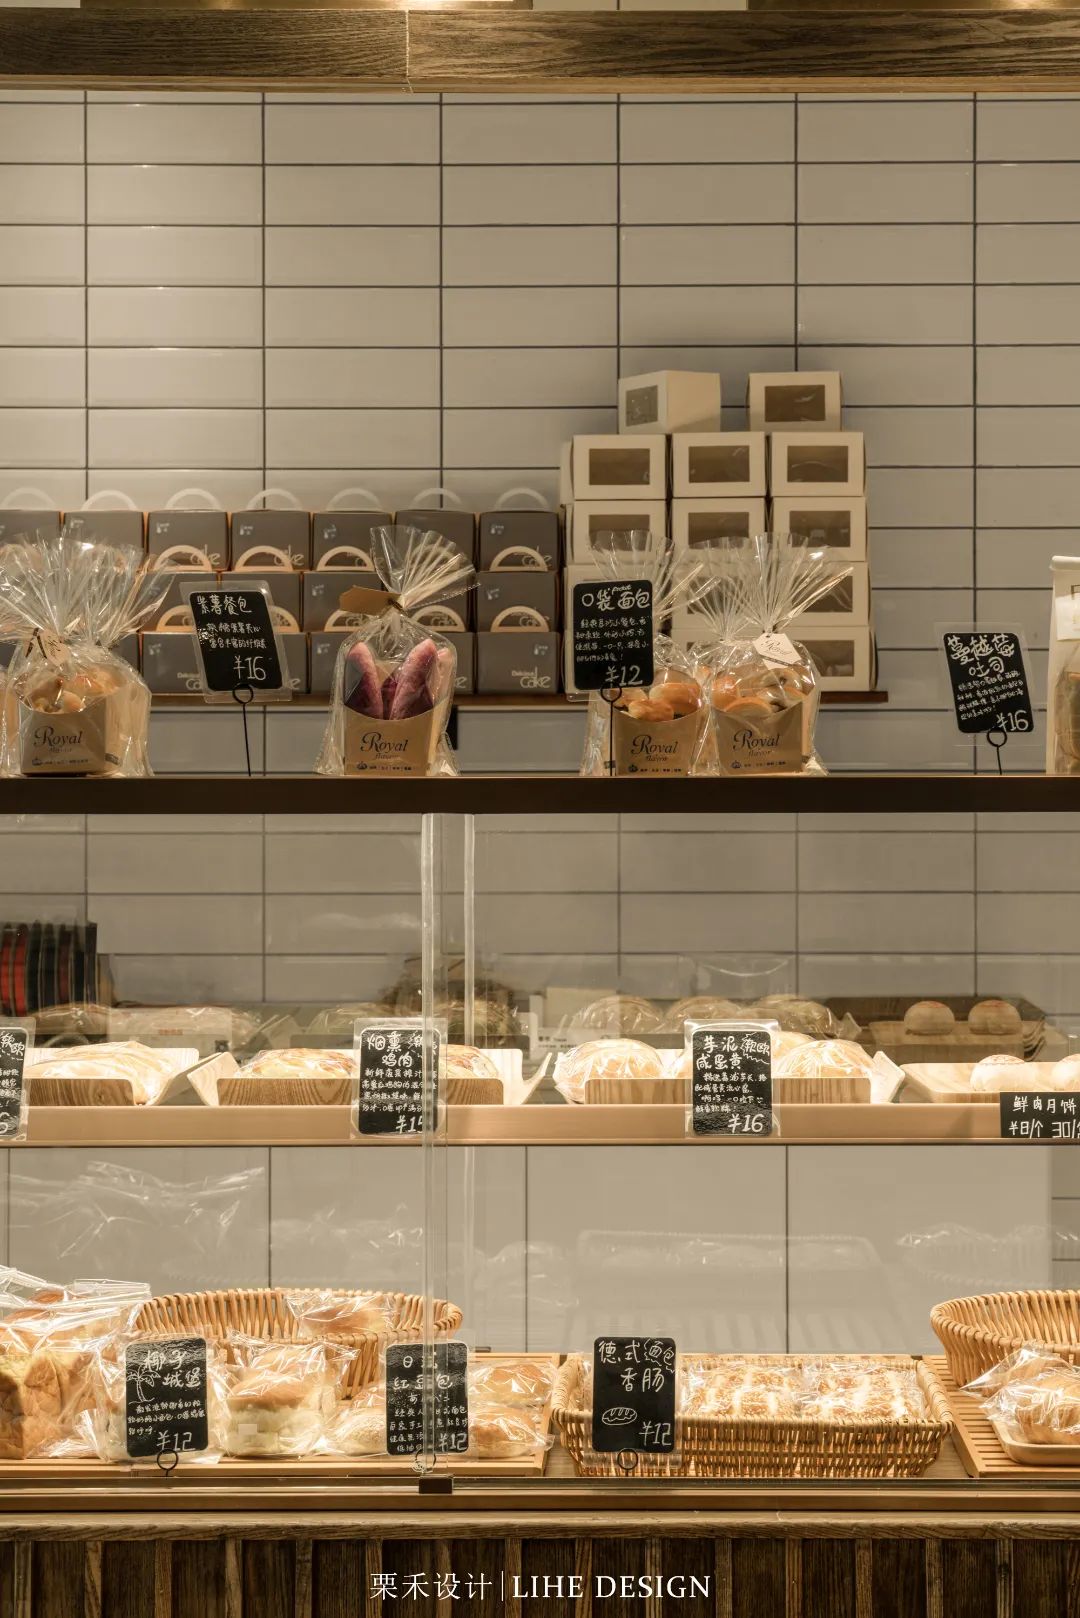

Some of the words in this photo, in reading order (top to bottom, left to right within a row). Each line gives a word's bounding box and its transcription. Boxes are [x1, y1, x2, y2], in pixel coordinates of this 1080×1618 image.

[197, 594, 252, 615] 紫薯餐包
[581, 588, 650, 611] 口袋面包
[947, 633, 1015, 665] 蔓越莓
[233, 655, 266, 680] ¥16
[604, 665, 643, 688] ¥12
[968, 656, 1004, 677] 吐司
[996, 710, 1029, 731] ¥16
[33, 725, 83, 747] Royal
[360, 731, 408, 753] Royal
[630, 734, 679, 754] Royal
[733, 729, 780, 750] Royal
[367, 1031, 401, 1052] 烟熏
[703, 1035, 739, 1053] 芋泥
[382, 1052, 413, 1067] 鸡肉
[696, 1053, 742, 1070] 咸蛋黄
[1012, 1096, 1077, 1115] 鲜肉月饼
[728, 1114, 764, 1133] ¥16
[144, 1350, 187, 1373] 椰子
[599, 1340, 640, 1364] 德式
[162, 1367, 201, 1388] 城堡
[620, 1367, 665, 1392] 香肠
[157, 1430, 196, 1451] ¥12
[439, 1432, 468, 1452] ¥12
[639, 1421, 672, 1446] ¥12
